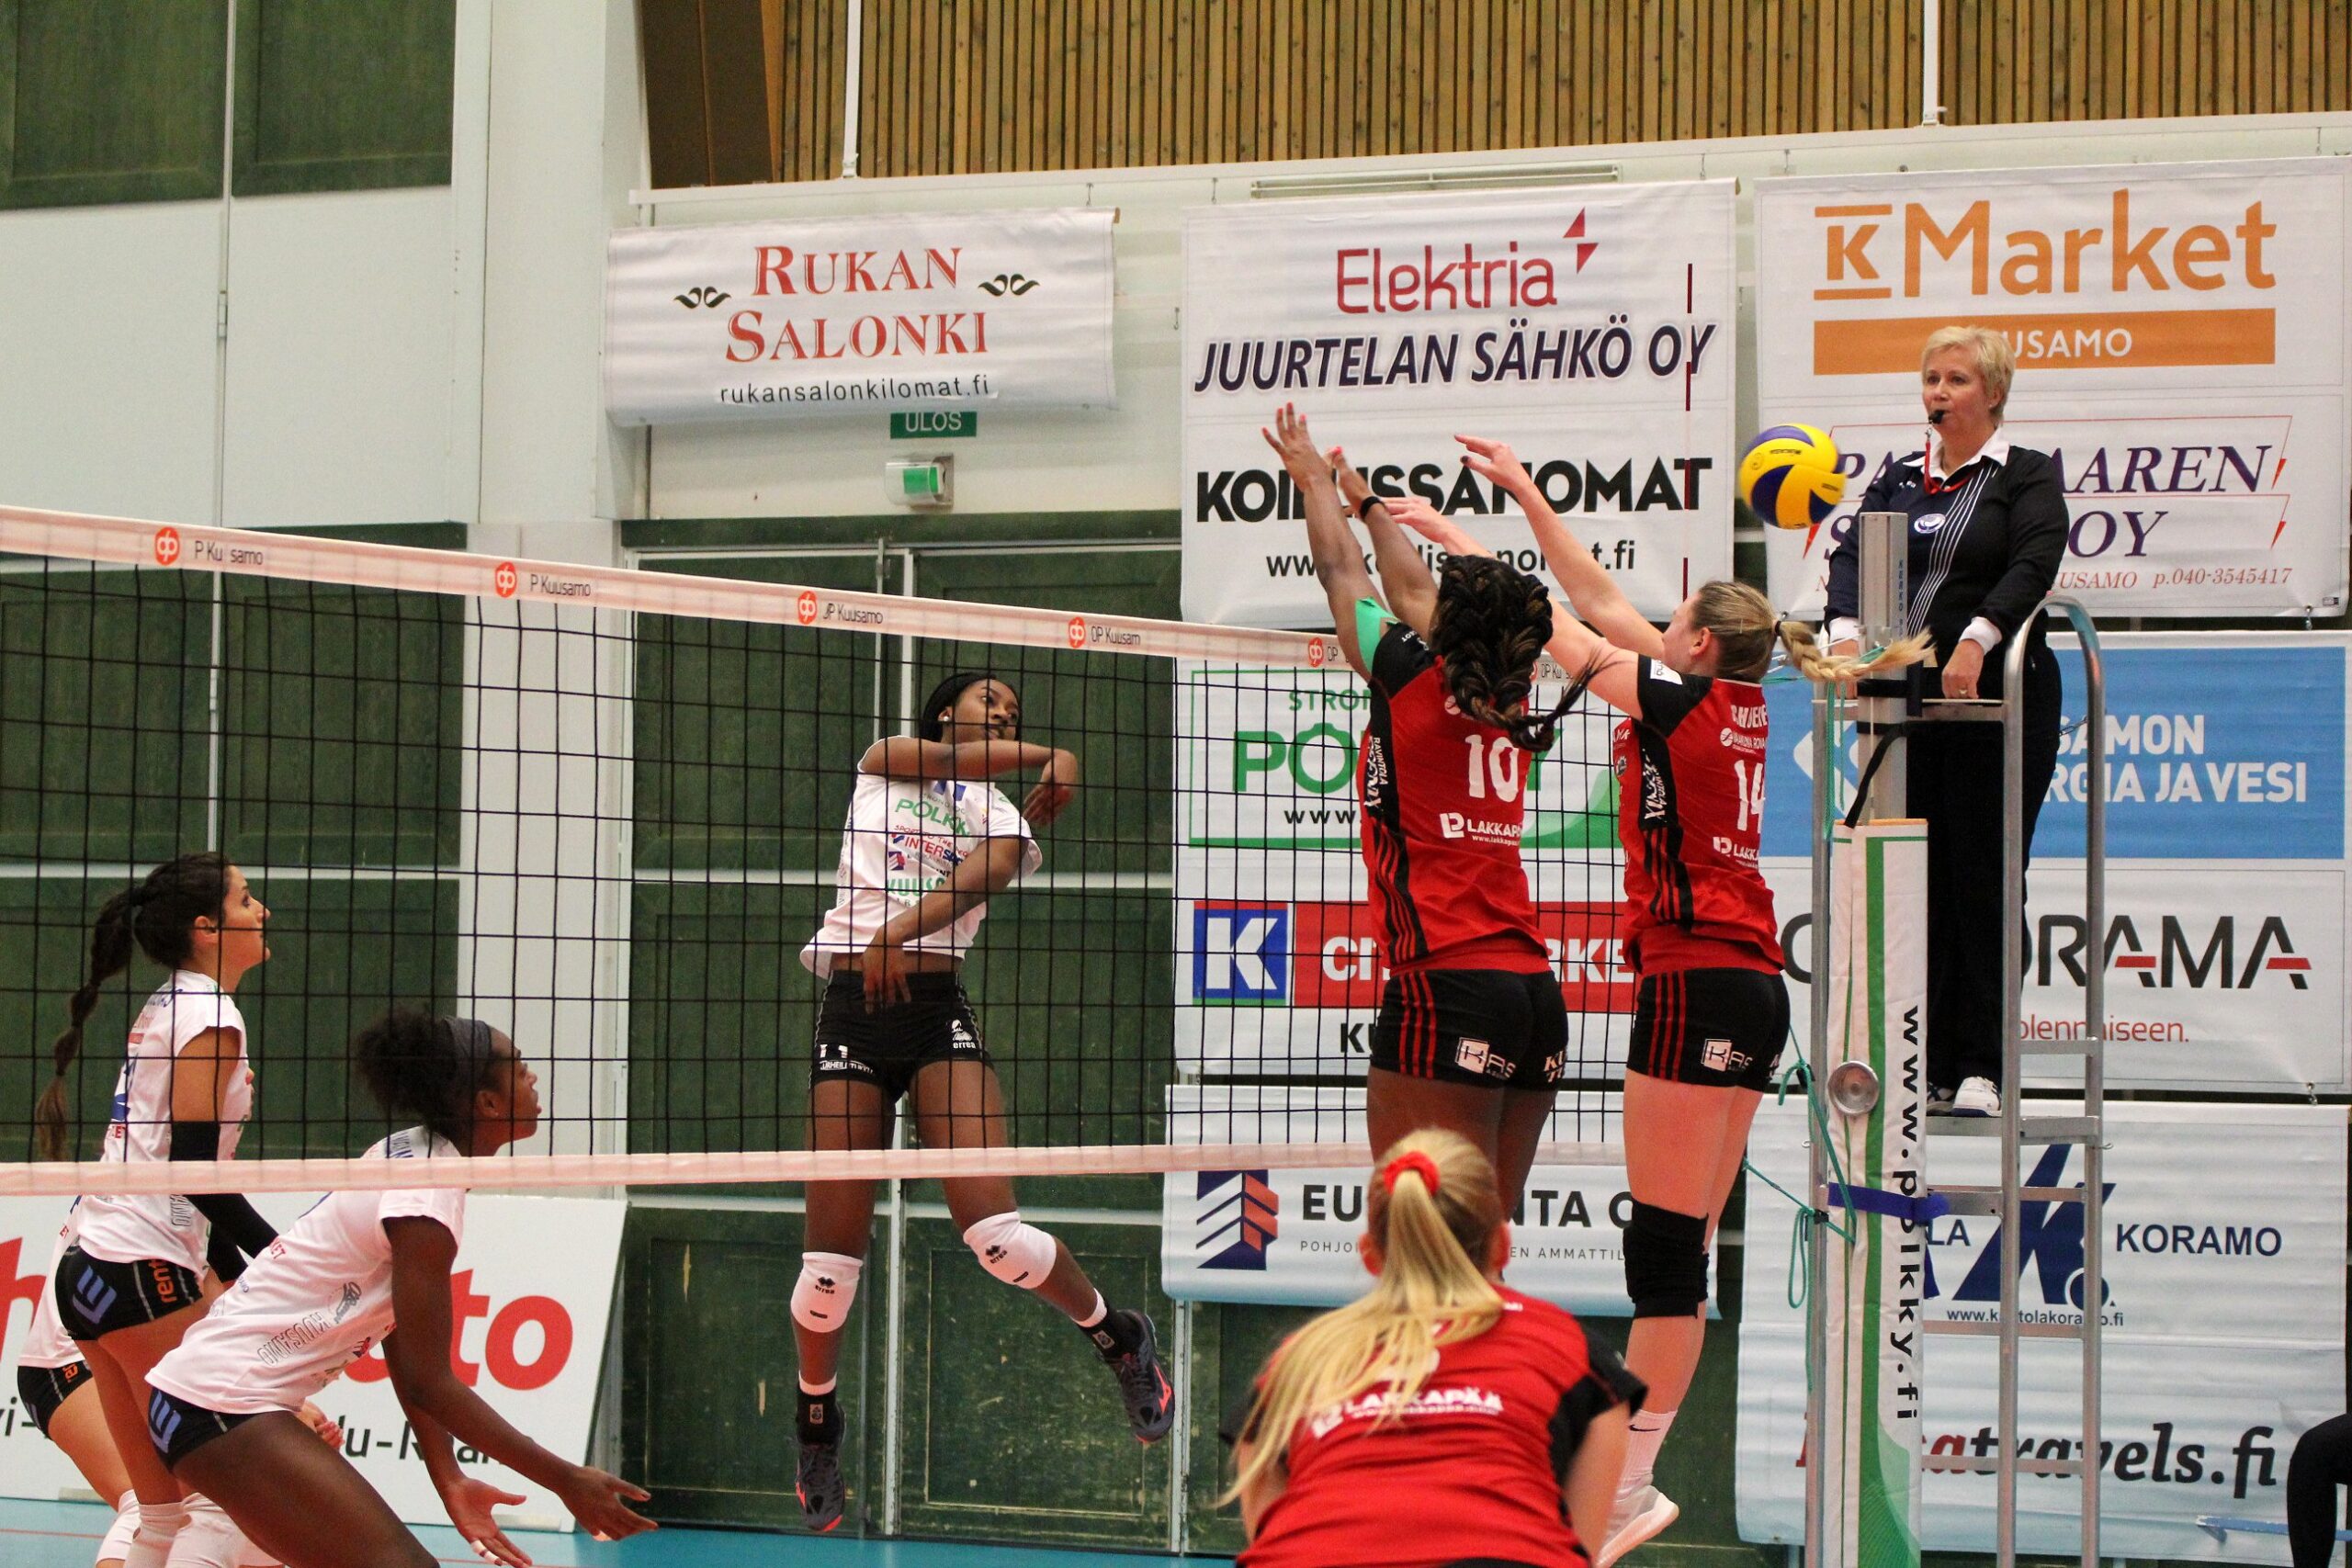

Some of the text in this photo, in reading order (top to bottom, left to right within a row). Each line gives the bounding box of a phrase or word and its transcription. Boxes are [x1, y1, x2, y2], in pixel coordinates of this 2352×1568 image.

[1903, 187, 2278, 299] Market
[752, 244, 963, 297] RUKAN
[1336, 241, 1557, 314] Elektria
[724, 310, 990, 364] SALONKI
[1193, 313, 1718, 393] JUURTELAN SÄHKÖ OY
[2002, 327, 2133, 359] USAMO
[719, 373, 990, 405] rukansalonkilomat.fi
[905, 412, 962, 433] ULOS
[2057, 566, 2293, 591] USAMO p.040-3545417
[837, 604, 884, 625] Kuusamo
[1464, 733, 1520, 804] 10
[2154, 761, 2203, 803] JA
[2205, 761, 2307, 803] VESI
[1733, 759, 1766, 834] 14
[1466, 818, 1521, 839] LAKKAP
[1205, 917, 1277, 990] K
[2115, 1223, 2283, 1258] KORAMO
[1947, 1308, 2124, 1326] www.ktolakorao.fi
